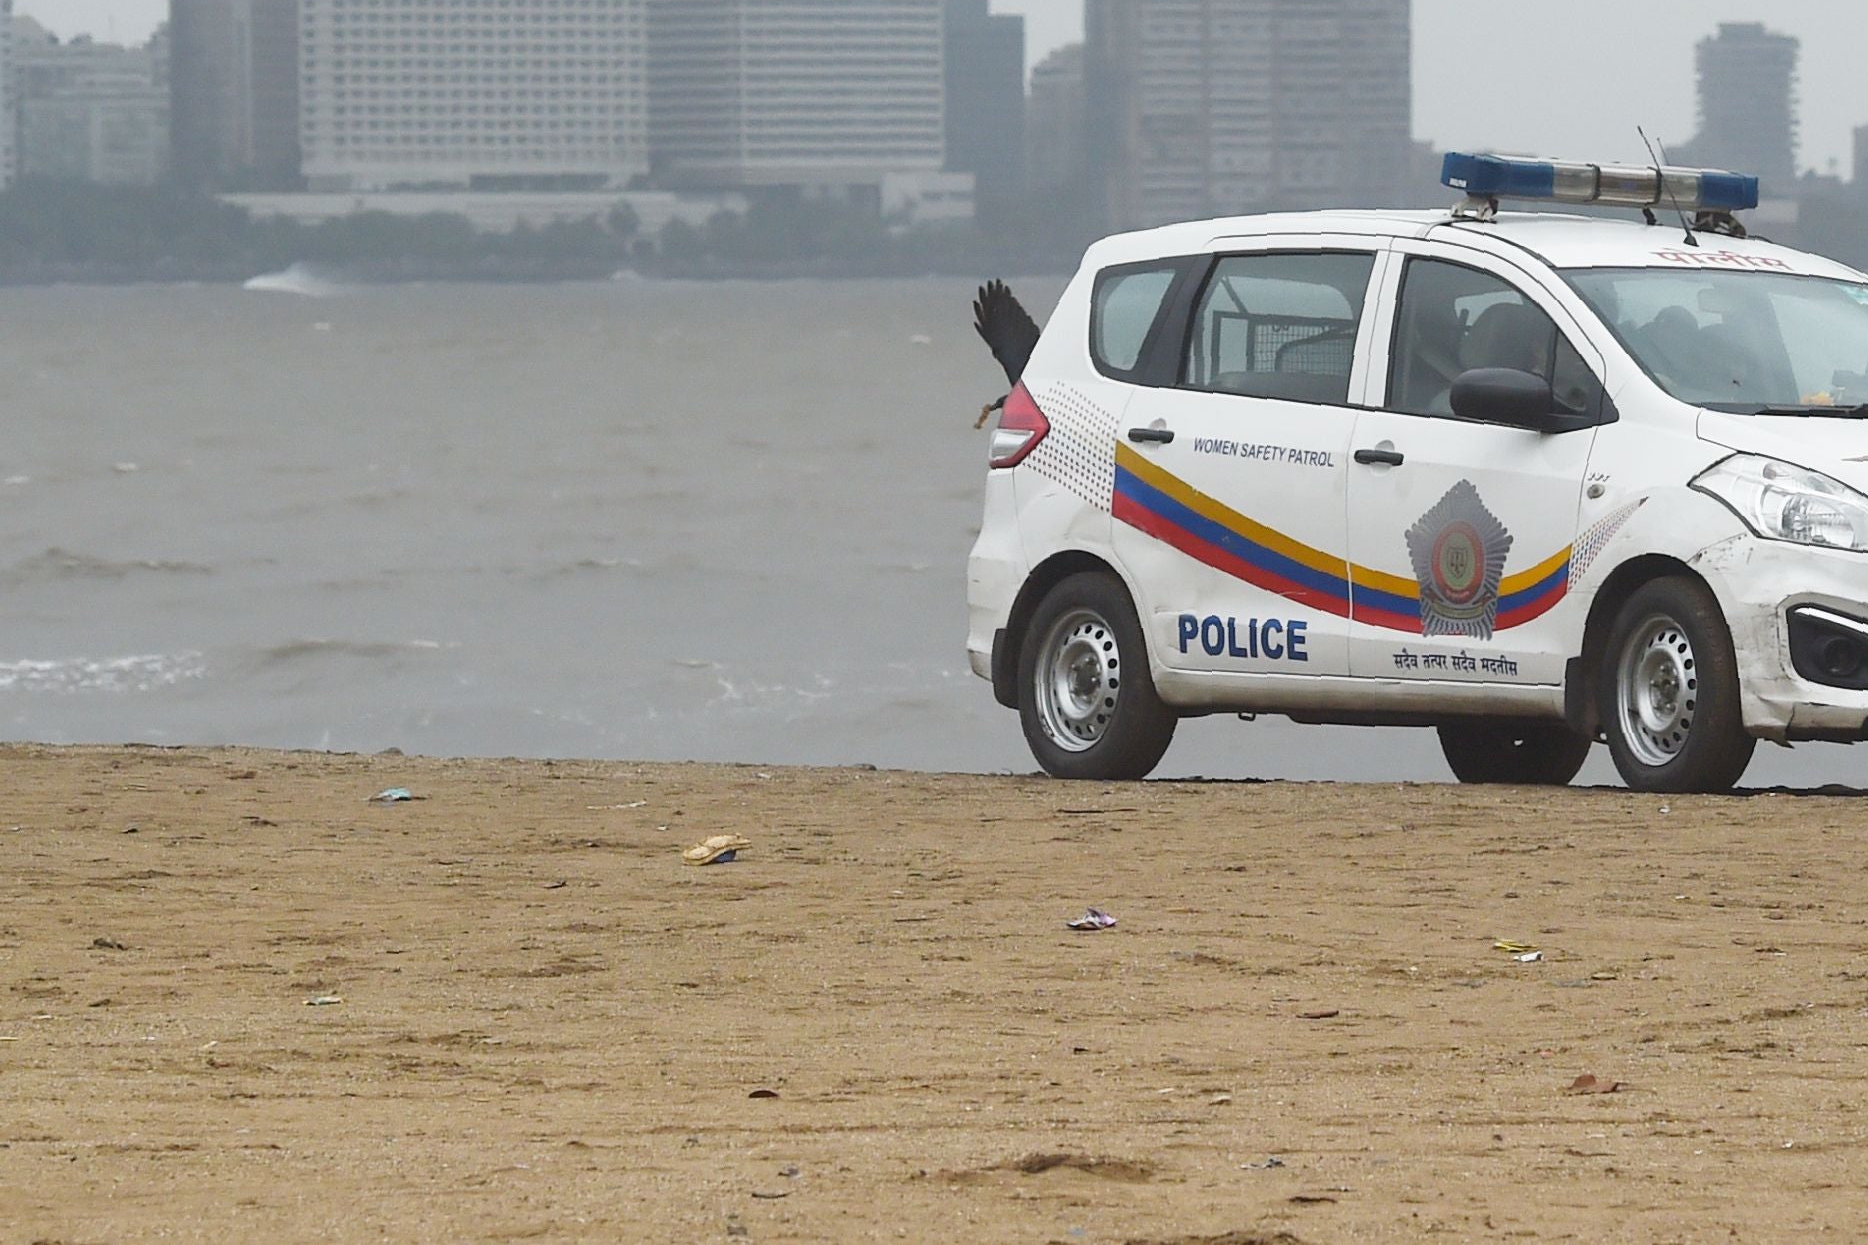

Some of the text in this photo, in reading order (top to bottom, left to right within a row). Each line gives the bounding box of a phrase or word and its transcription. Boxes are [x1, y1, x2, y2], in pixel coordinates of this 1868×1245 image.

[1649, 247, 1795, 271] पोलीस
[1194, 437, 1334, 468] WOMEN SAFETY PATROL
[1177, 614, 1309, 662] POLICE
[1392, 647, 1419, 670] सदैव
[1421, 653, 1448, 671] तत्पर
[1450, 649, 1477, 673] सदैव
